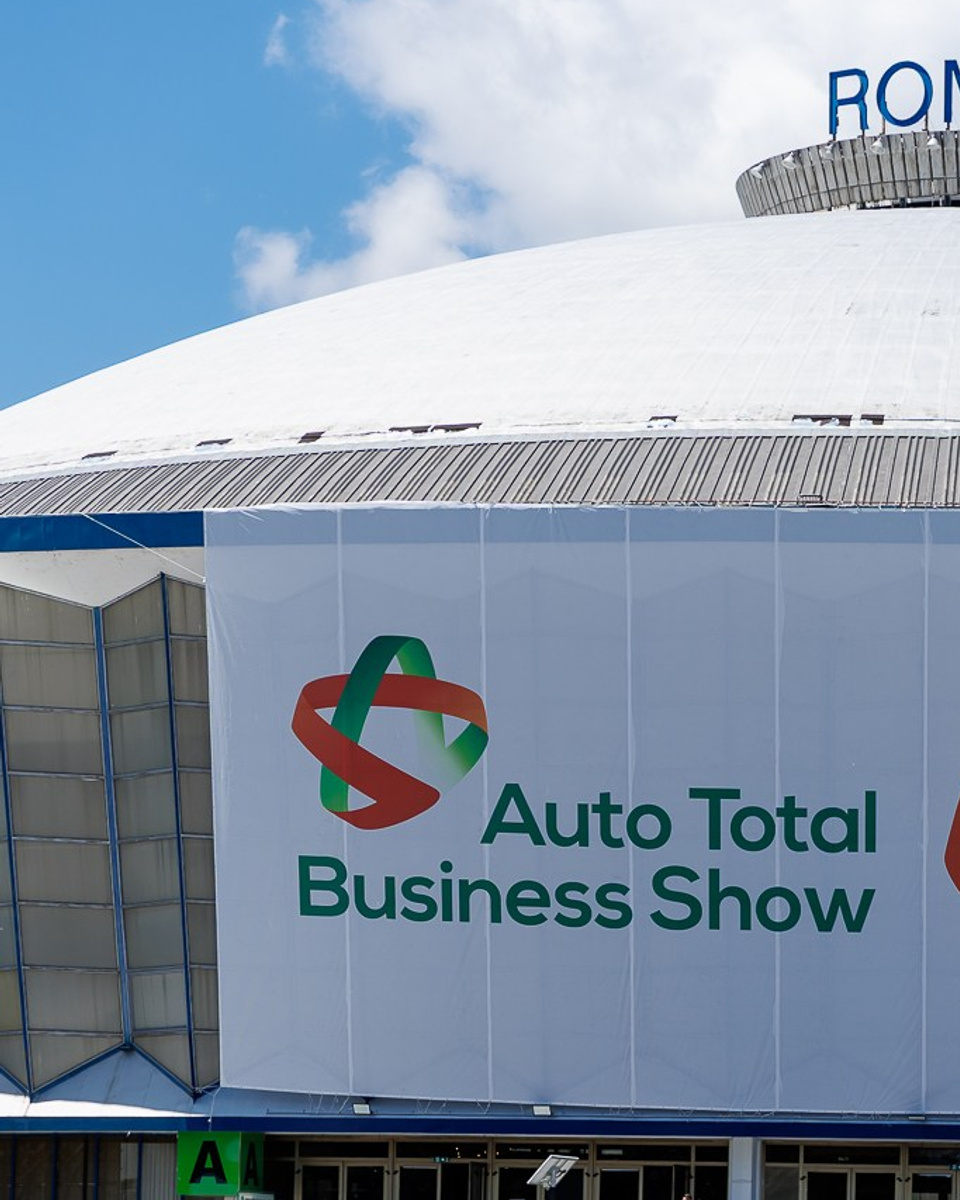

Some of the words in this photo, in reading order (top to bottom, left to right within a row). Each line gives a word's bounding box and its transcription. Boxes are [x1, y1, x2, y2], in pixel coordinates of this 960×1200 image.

[480, 783, 672, 850] Auto
[688, 787, 877, 853] Total
[298, 855, 633, 929] Business
[649, 865, 876, 933] Show
[188, 1141, 227, 1184] A
[244, 1142, 259, 1186] A
